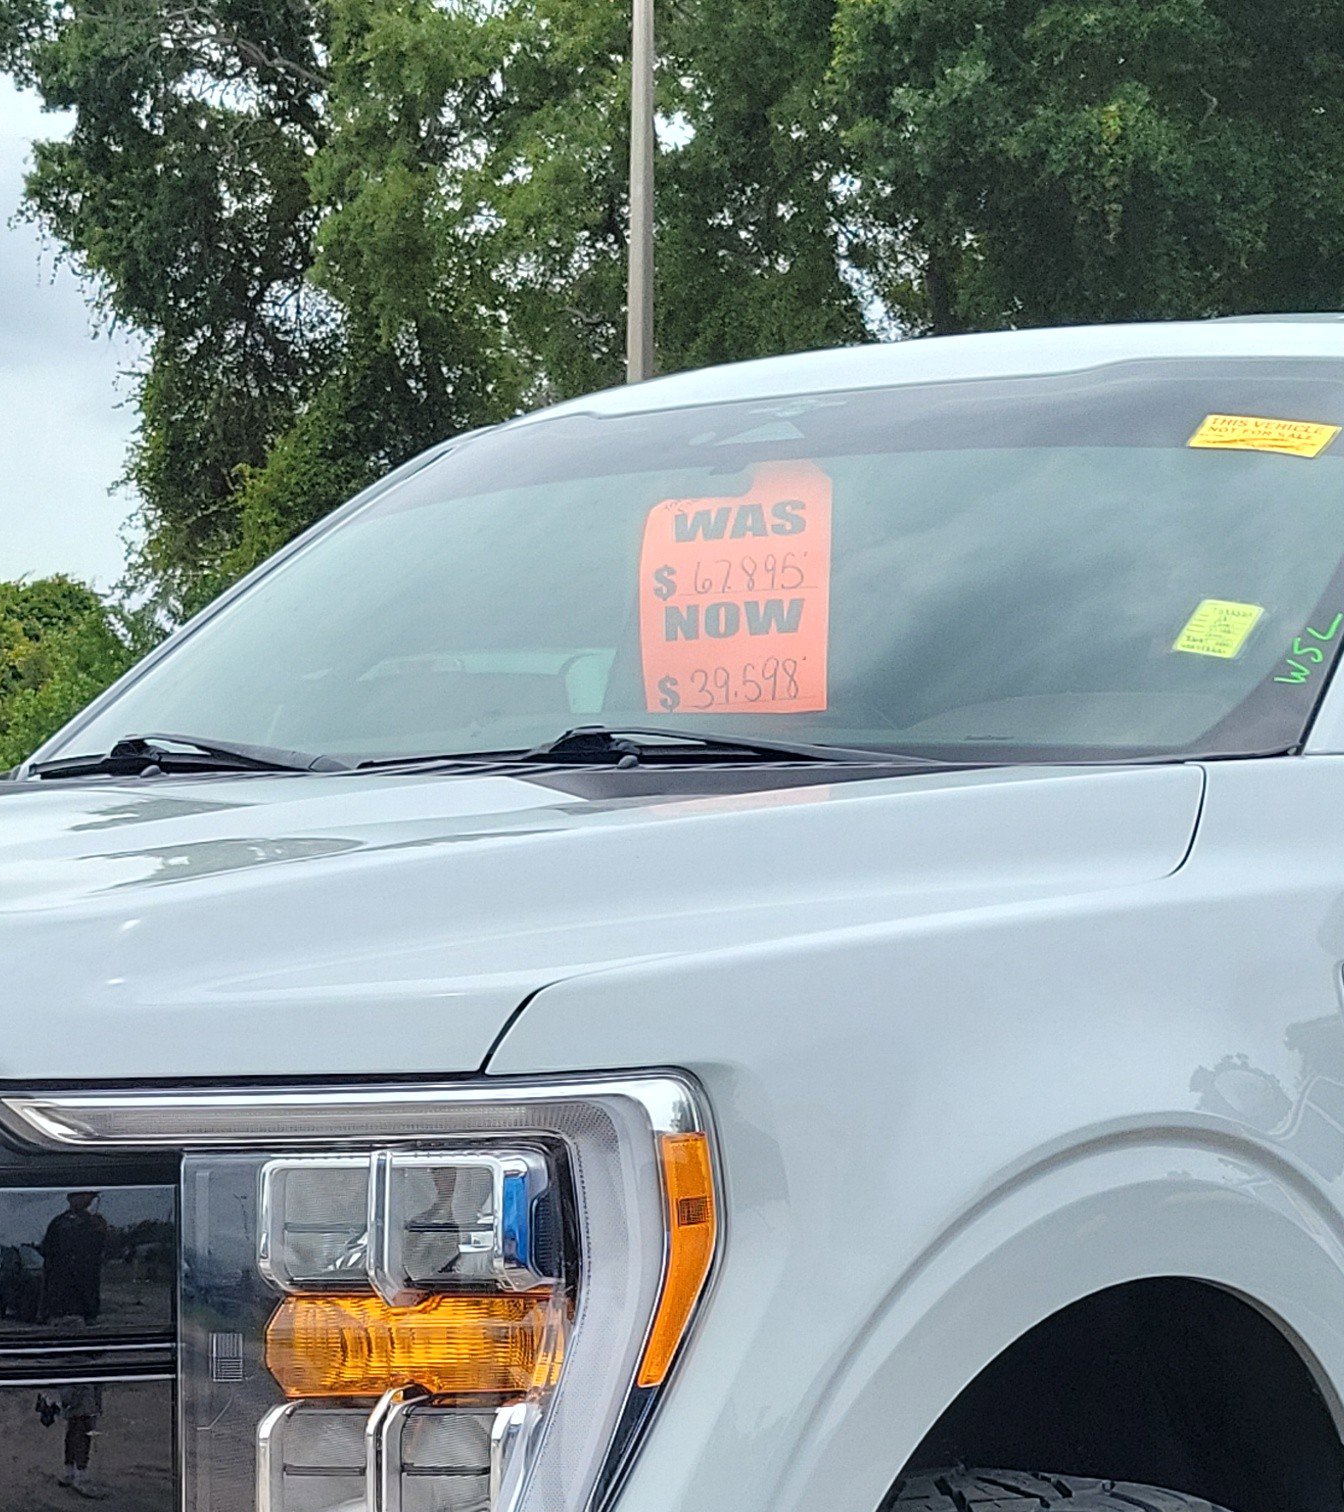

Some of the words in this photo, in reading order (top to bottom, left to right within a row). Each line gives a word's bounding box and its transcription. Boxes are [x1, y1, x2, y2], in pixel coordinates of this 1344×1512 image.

[1211, 417, 1249, 427] THIS
[1253, 420, 1327, 435] VEHICLE
[674, 500, 806, 543] WAS
[653, 564, 677, 600] $
[665, 598, 805, 642] NOW
[657, 673, 681, 711] $
